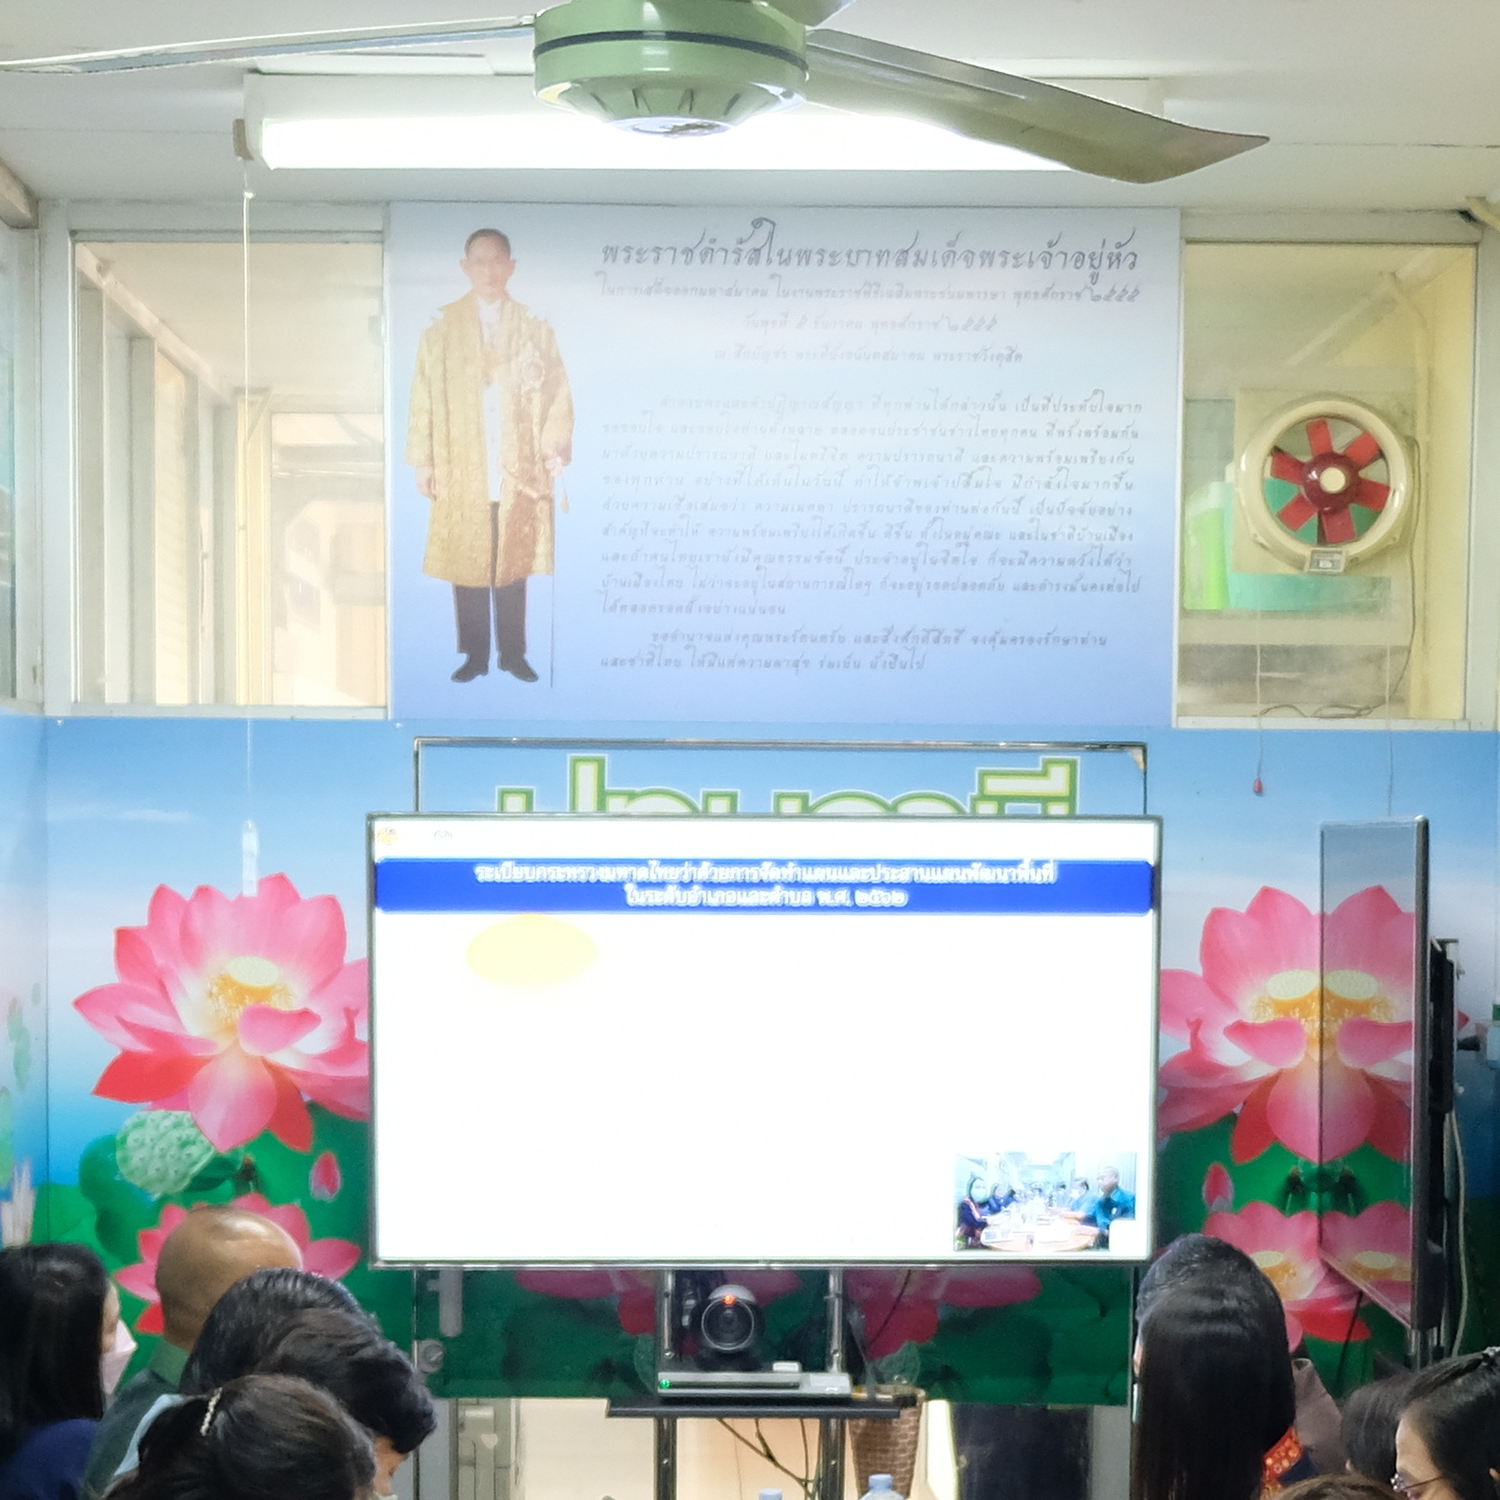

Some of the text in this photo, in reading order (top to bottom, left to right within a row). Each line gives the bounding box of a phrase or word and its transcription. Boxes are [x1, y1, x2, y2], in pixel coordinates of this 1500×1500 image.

[602, 217, 1138, 285] พระราชดำรัสในพระบาทสมเด็จพระเจ้าอยู่หัว
